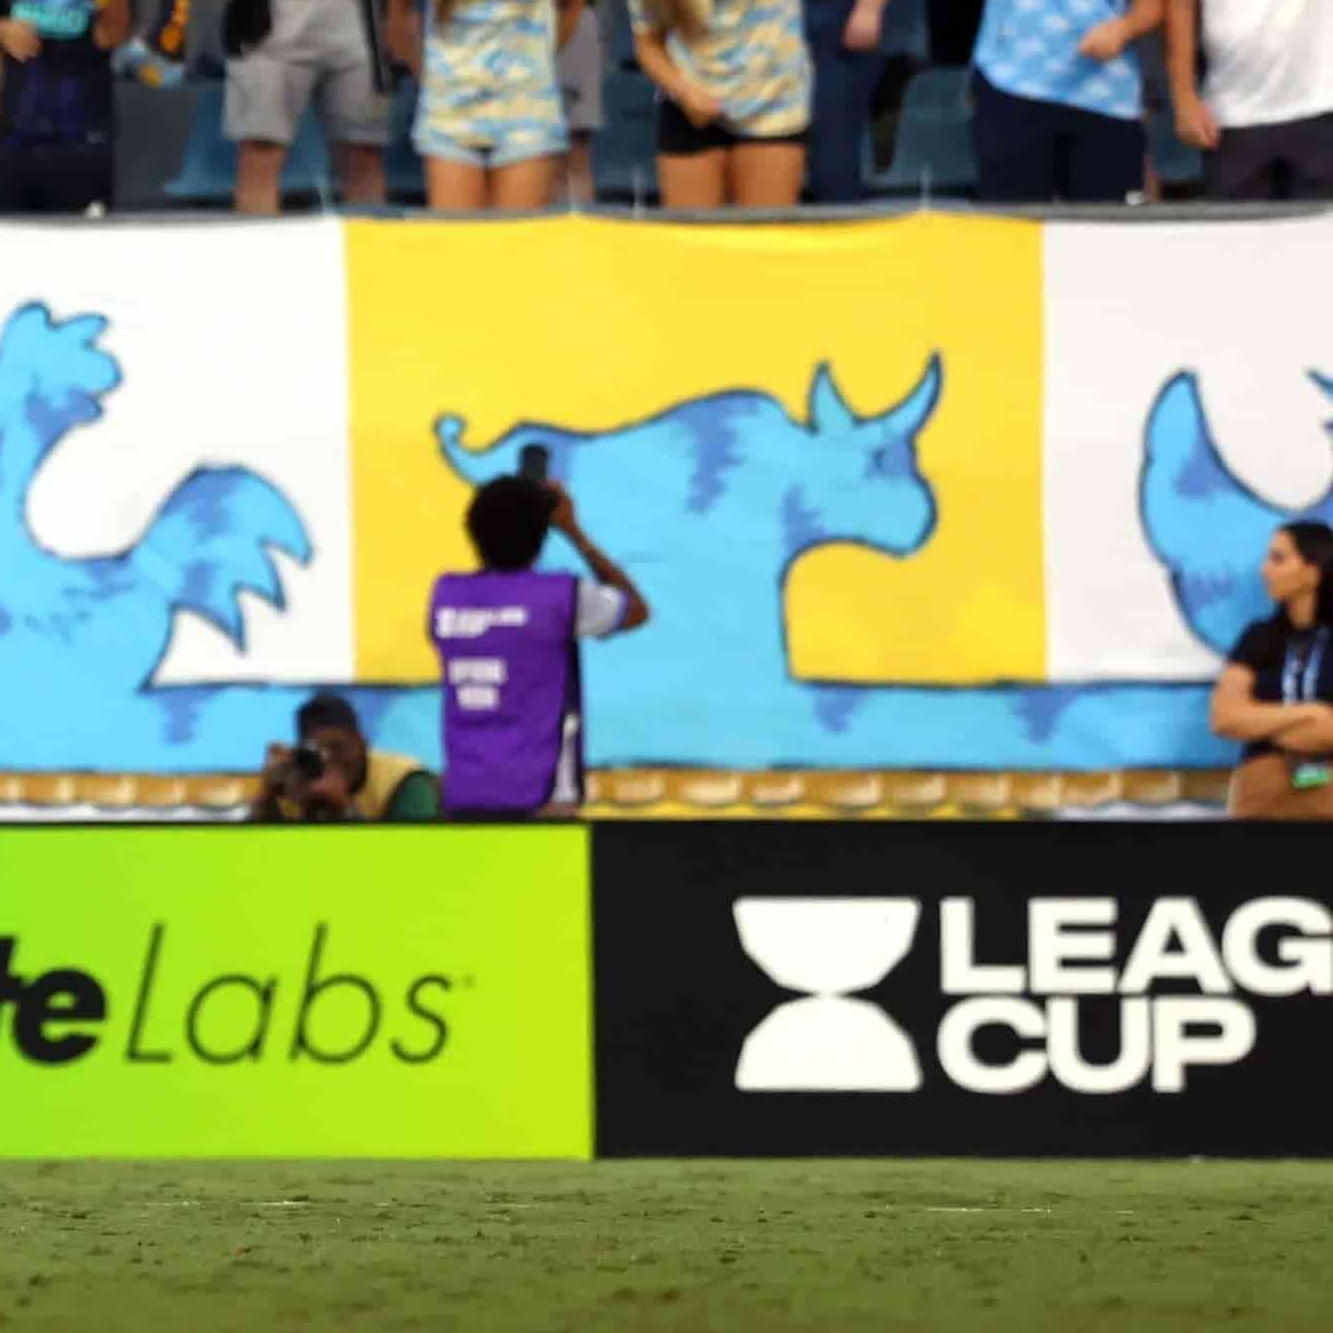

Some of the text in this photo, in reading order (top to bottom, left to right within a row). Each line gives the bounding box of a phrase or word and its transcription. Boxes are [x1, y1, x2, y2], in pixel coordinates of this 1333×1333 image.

[123, 921, 450, 1065] Labs
[939, 897, 1333, 996] LEAG
[936, 993, 1256, 1094] CUP
